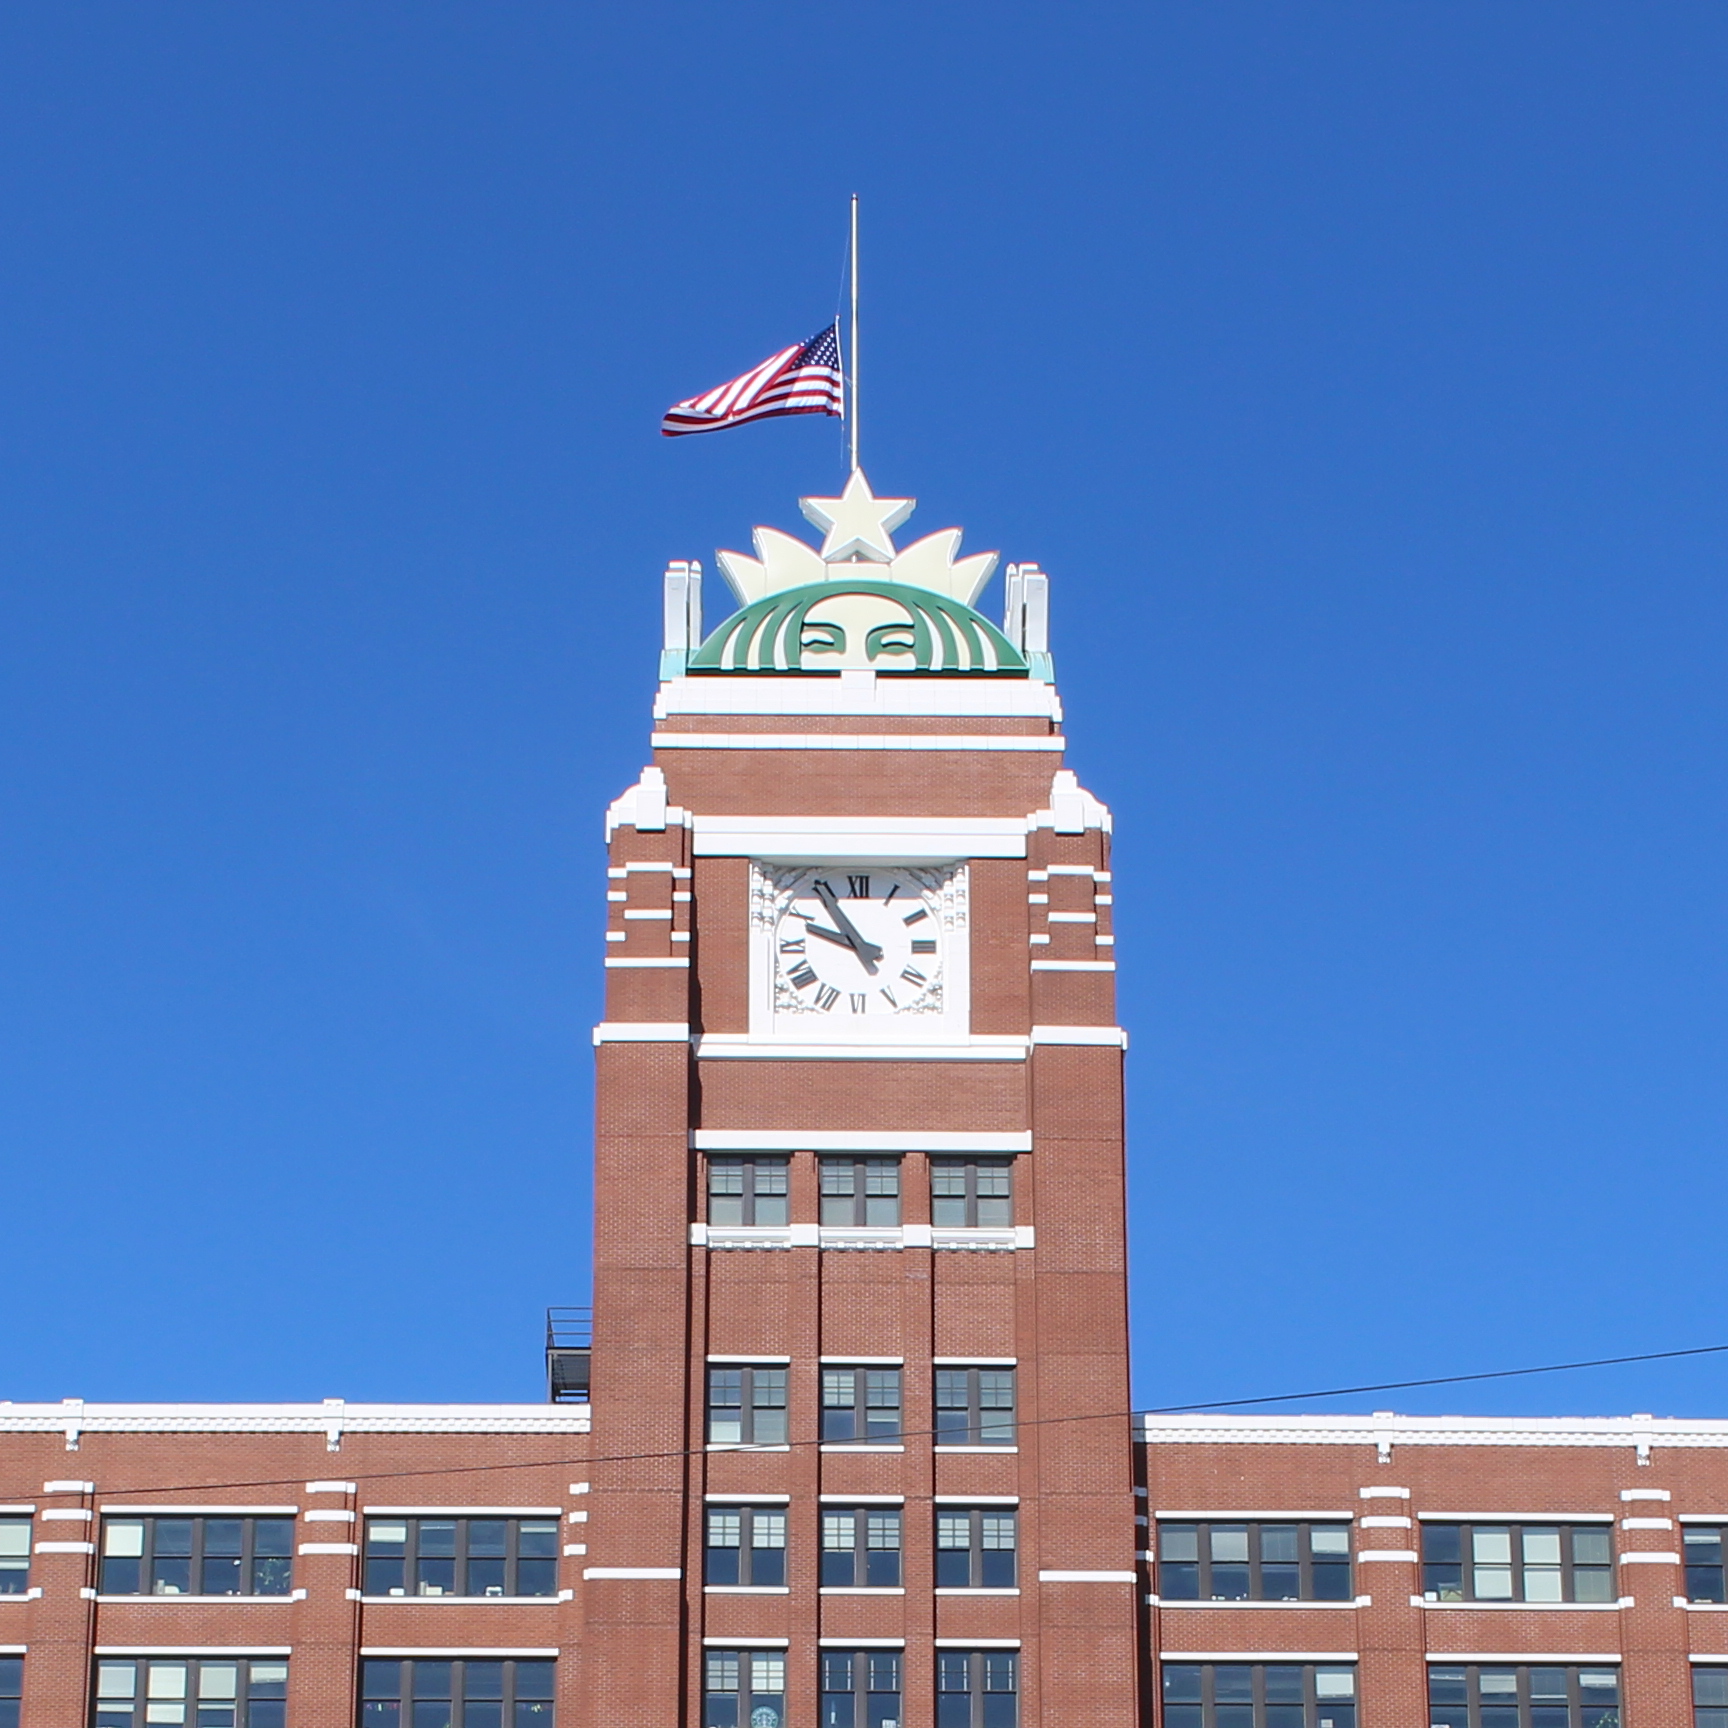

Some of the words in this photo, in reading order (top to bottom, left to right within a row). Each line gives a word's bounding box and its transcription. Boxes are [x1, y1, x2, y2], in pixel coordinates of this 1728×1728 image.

[847, 875, 870, 898] XII
[883, 883, 901, 908] I
[779, 937, 806, 955] IX
[911, 939, 937, 955] III
[785, 957, 820, 991] VIII
[813, 981, 842, 1013] VII
[848, 992, 867, 1014] VI
[878, 984, 899, 1009] V
